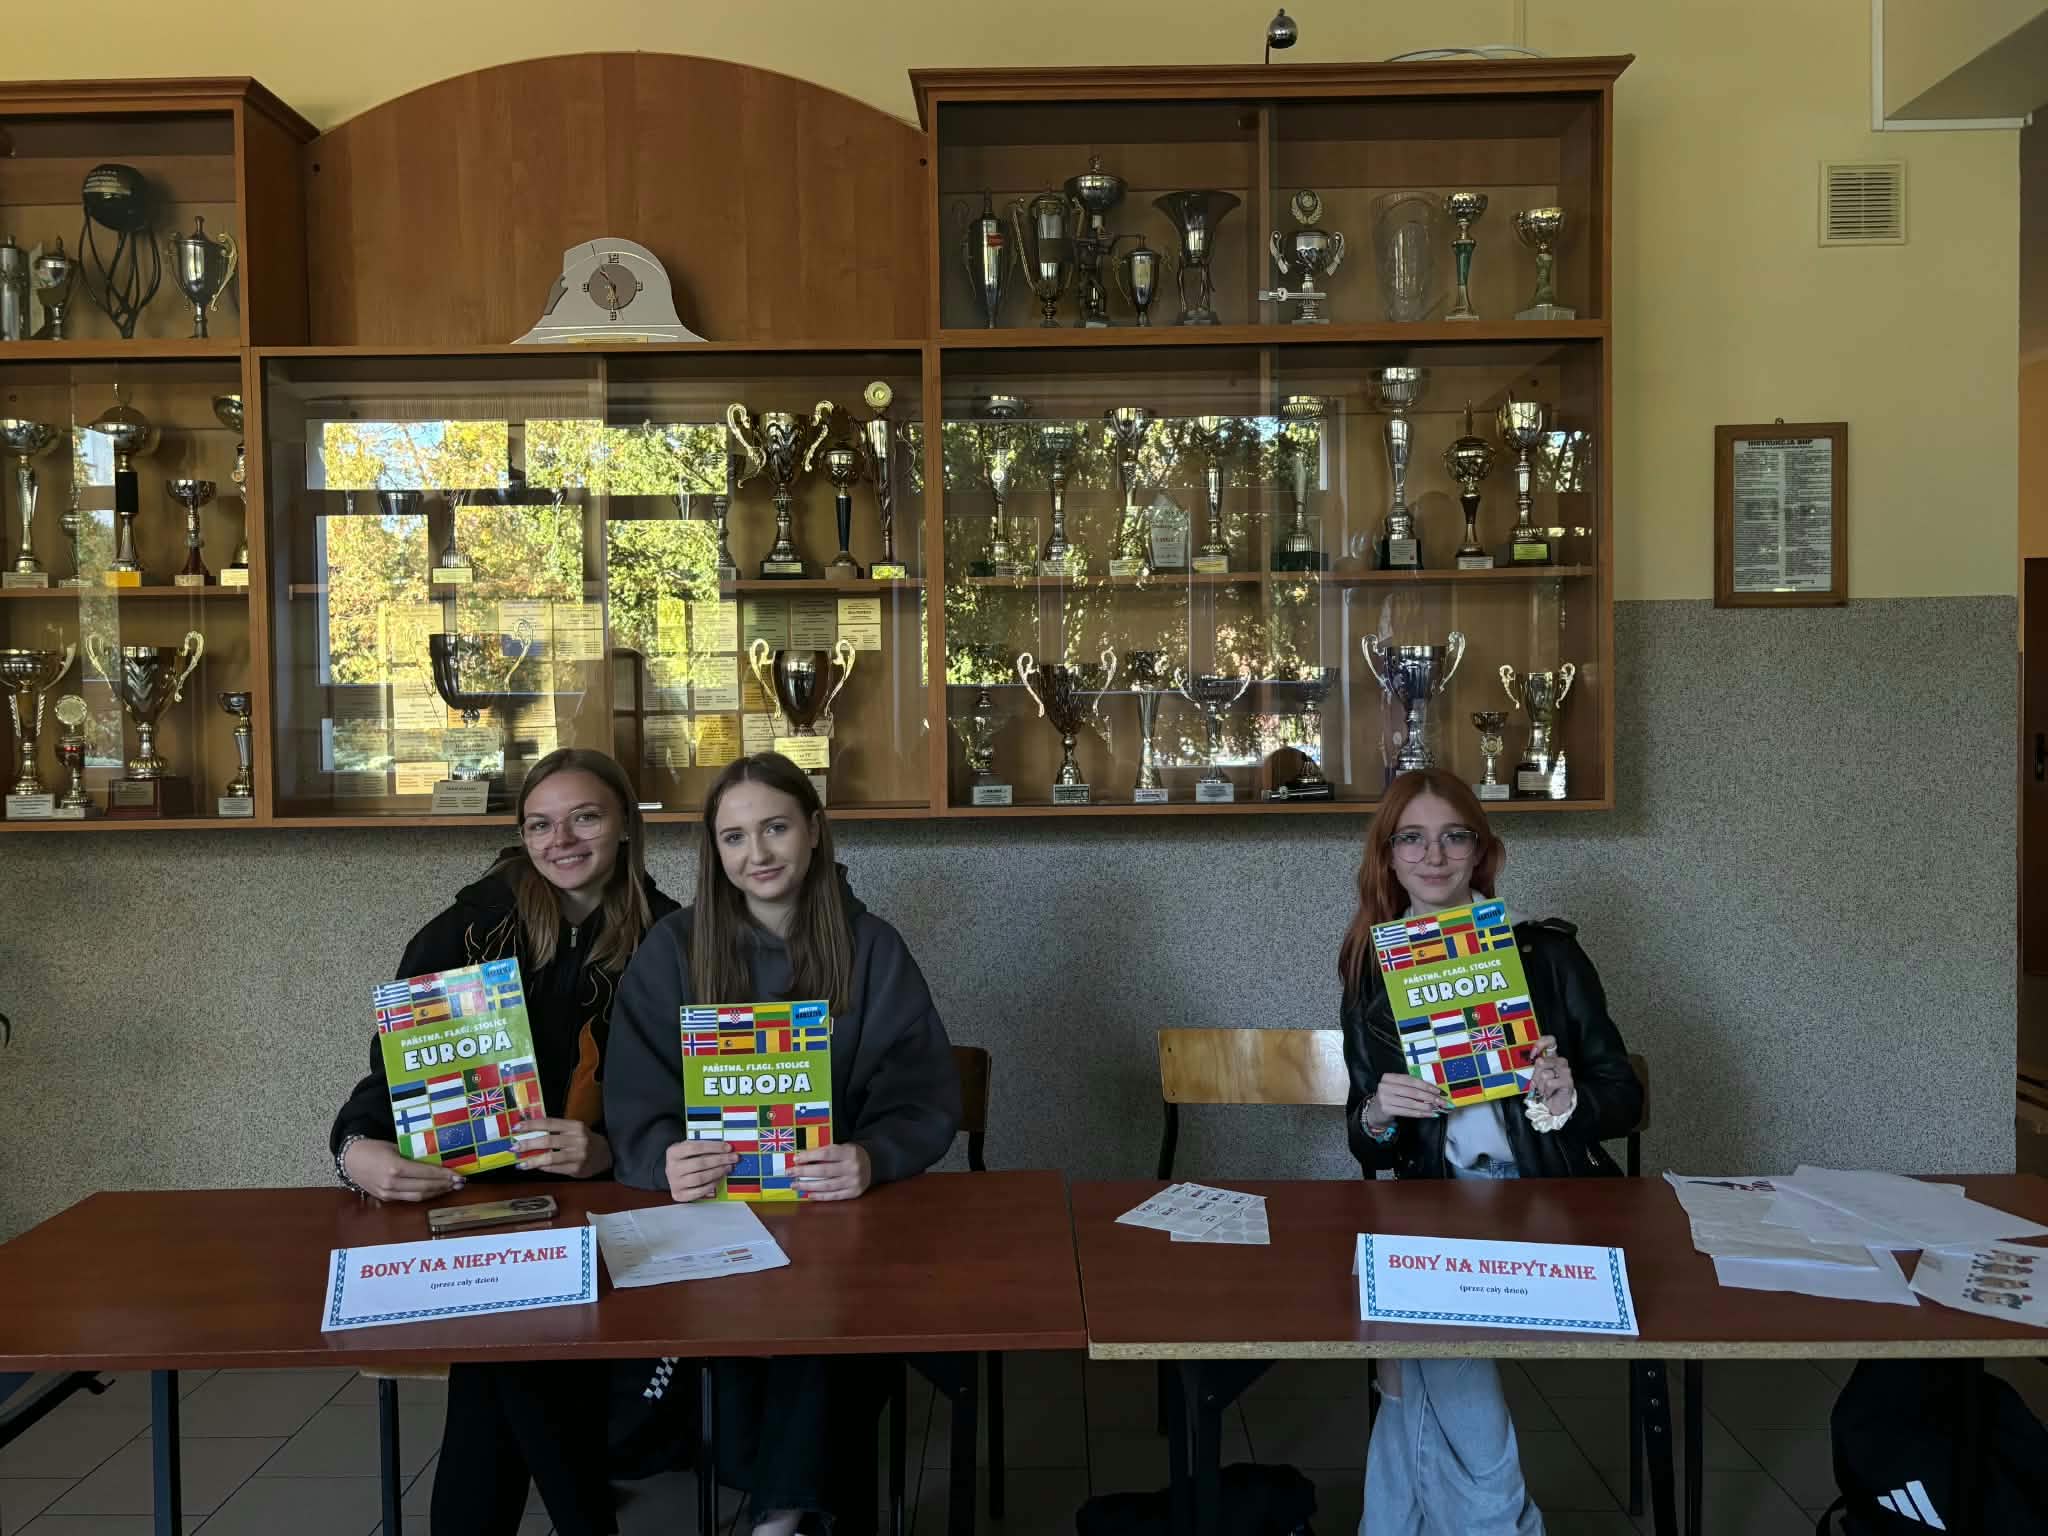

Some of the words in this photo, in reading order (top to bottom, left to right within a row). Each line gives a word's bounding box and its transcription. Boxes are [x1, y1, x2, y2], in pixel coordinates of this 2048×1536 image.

[1469, 959, 1502, 972] STOLICE
[1406, 971, 1508, 1009] EUROPA
[473, 1018, 508, 1032] STOLICE
[403, 1030, 513, 1073] EUROPA
[775, 1061, 811, 1070] STOLICE
[703, 1072, 813, 1097] EUROPA
[360, 1257, 417, 1280] BONY
[419, 1255, 447, 1274] NA
[452, 1245, 569, 1270] NIEPYTANIE
[1388, 1254, 1442, 1271] BONY
[1446, 1257, 1473, 1274] NA
[1479, 1259, 1598, 1281] NIEPYTANIE
